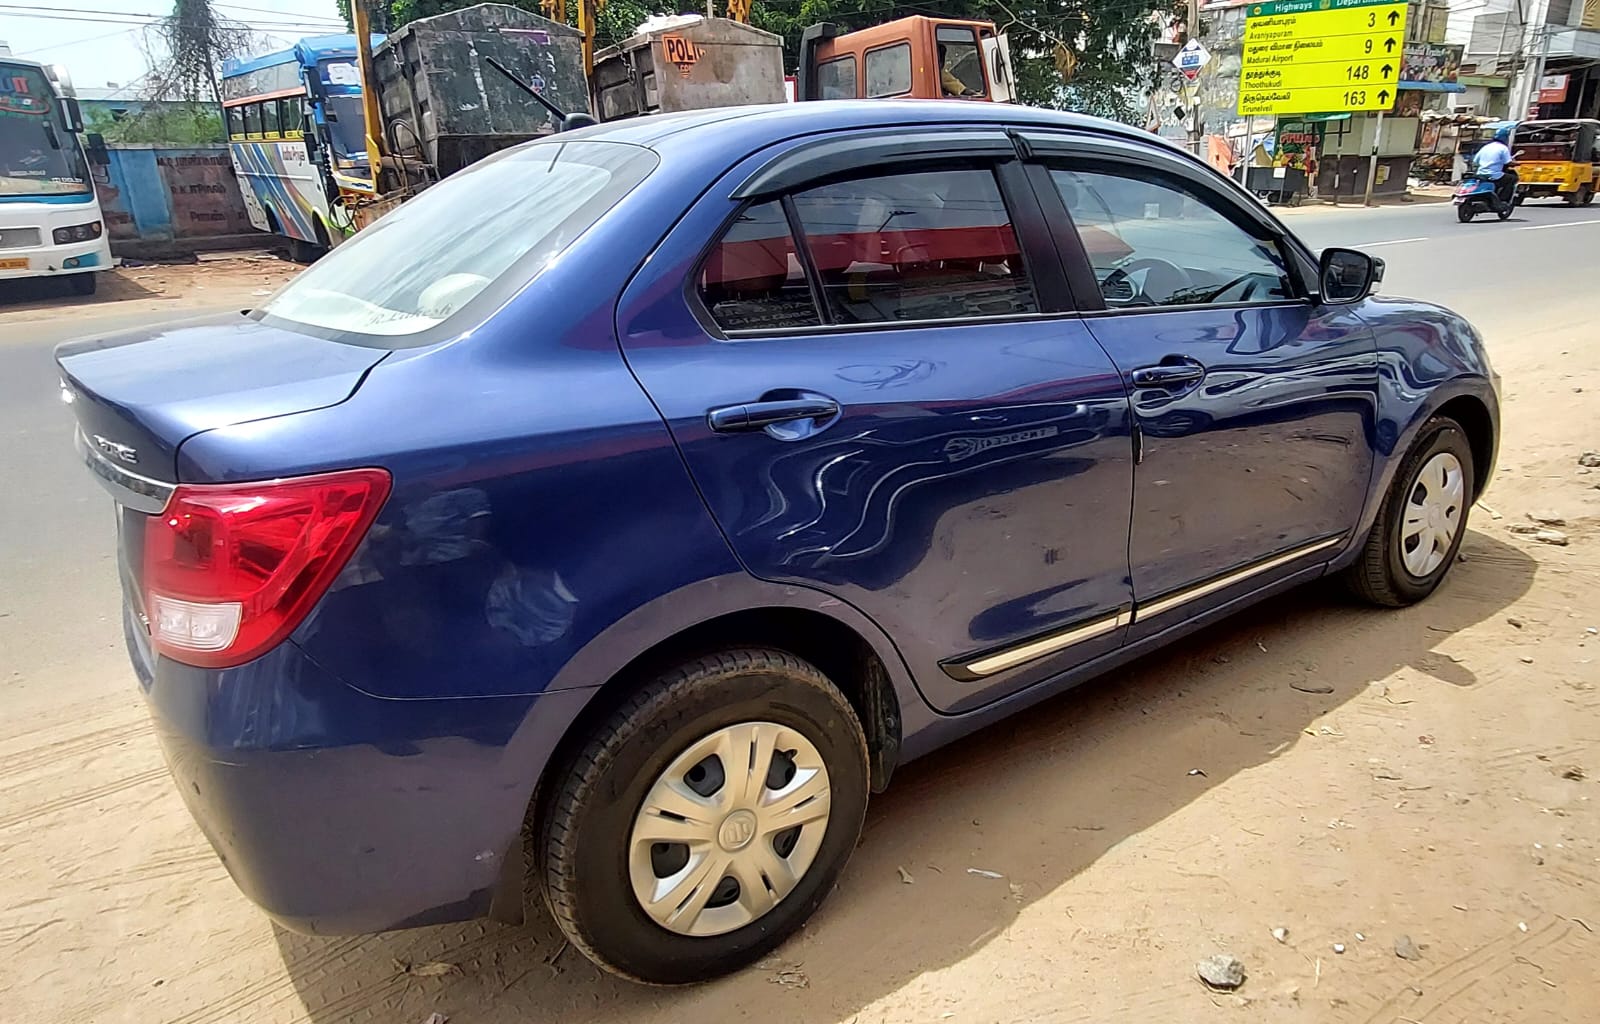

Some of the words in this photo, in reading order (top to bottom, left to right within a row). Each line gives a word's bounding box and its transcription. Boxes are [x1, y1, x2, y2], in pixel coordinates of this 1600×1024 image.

[1274, 2, 1313, 13] Highways
[1368, 12, 1376, 28] 3
[1249, 30, 1293, 40] Avaniyapuram
[1364, 39, 1373, 54] 9
[1246, 55, 1271, 64] Madurai
[1271, 54, 1294, 63] Airport
[1346, 65, 1370, 81] 148
[1244, 80, 1283, 89] Thoothukudi
[1343, 90, 1367, 106] 163
[1241, 104, 1274, 113] Tirunelveli
